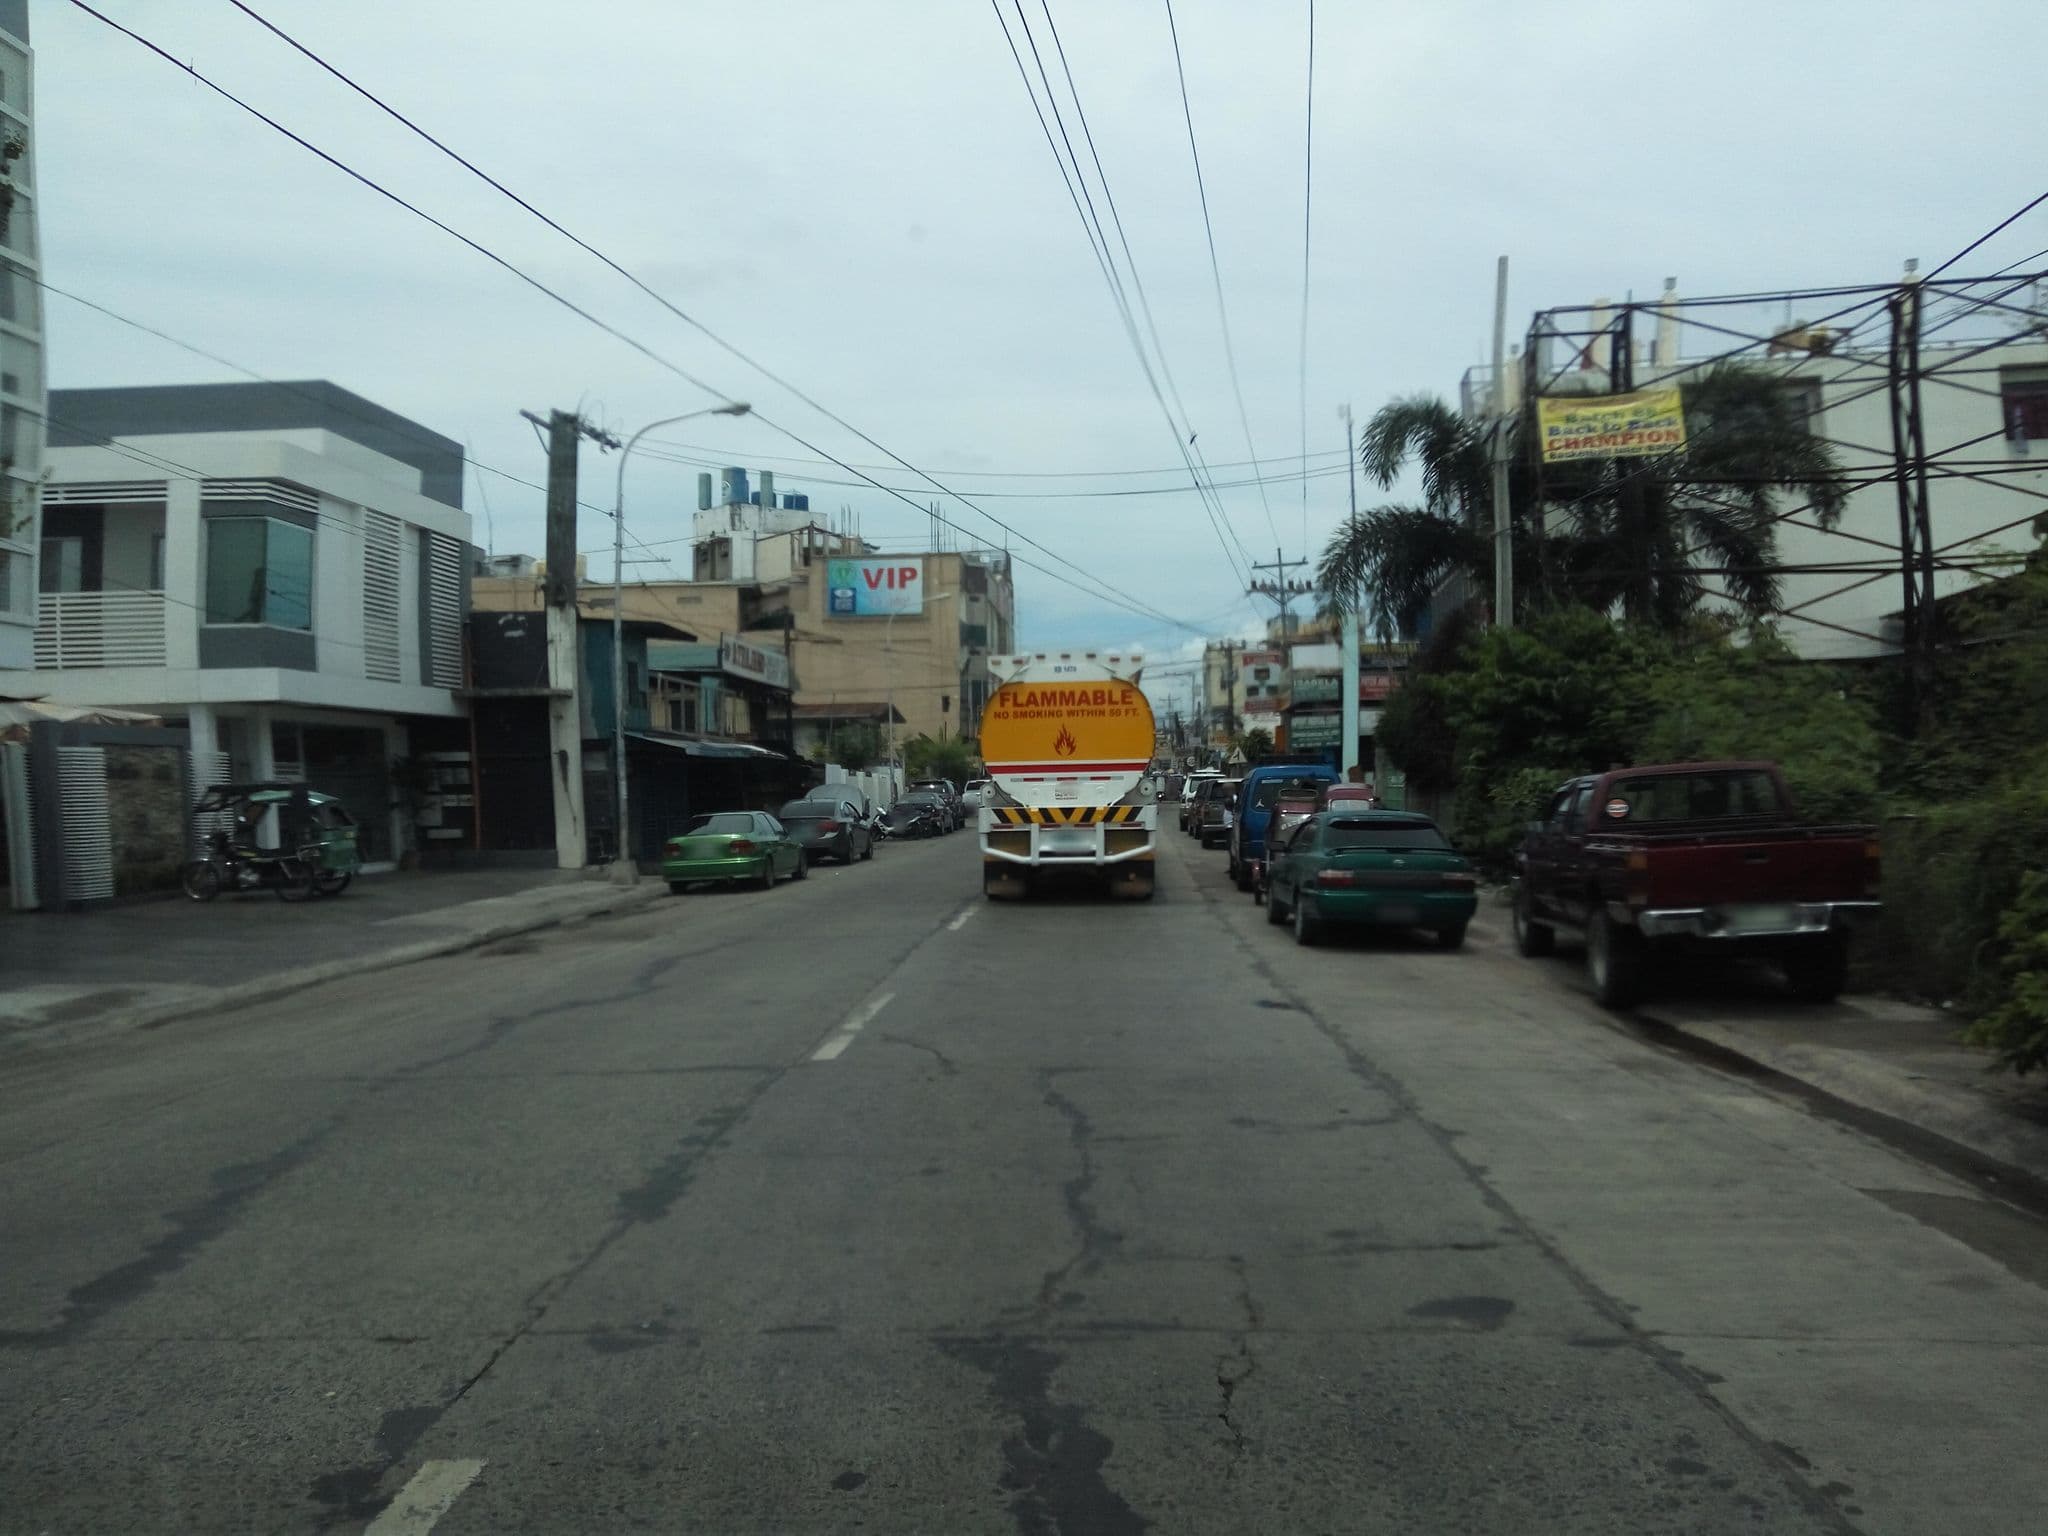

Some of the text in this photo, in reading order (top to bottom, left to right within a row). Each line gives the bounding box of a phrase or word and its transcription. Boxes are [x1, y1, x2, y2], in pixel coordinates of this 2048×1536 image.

[1548, 416, 1678, 436] Back to Back
[1548, 430, 1678, 450] CHAMPION
[863, 567, 918, 590] VIP
[1000, 689, 1134, 708] FLAMMABLE
[994, 708, 1140, 720] NO SMOKING WITHIN 50 FT.
